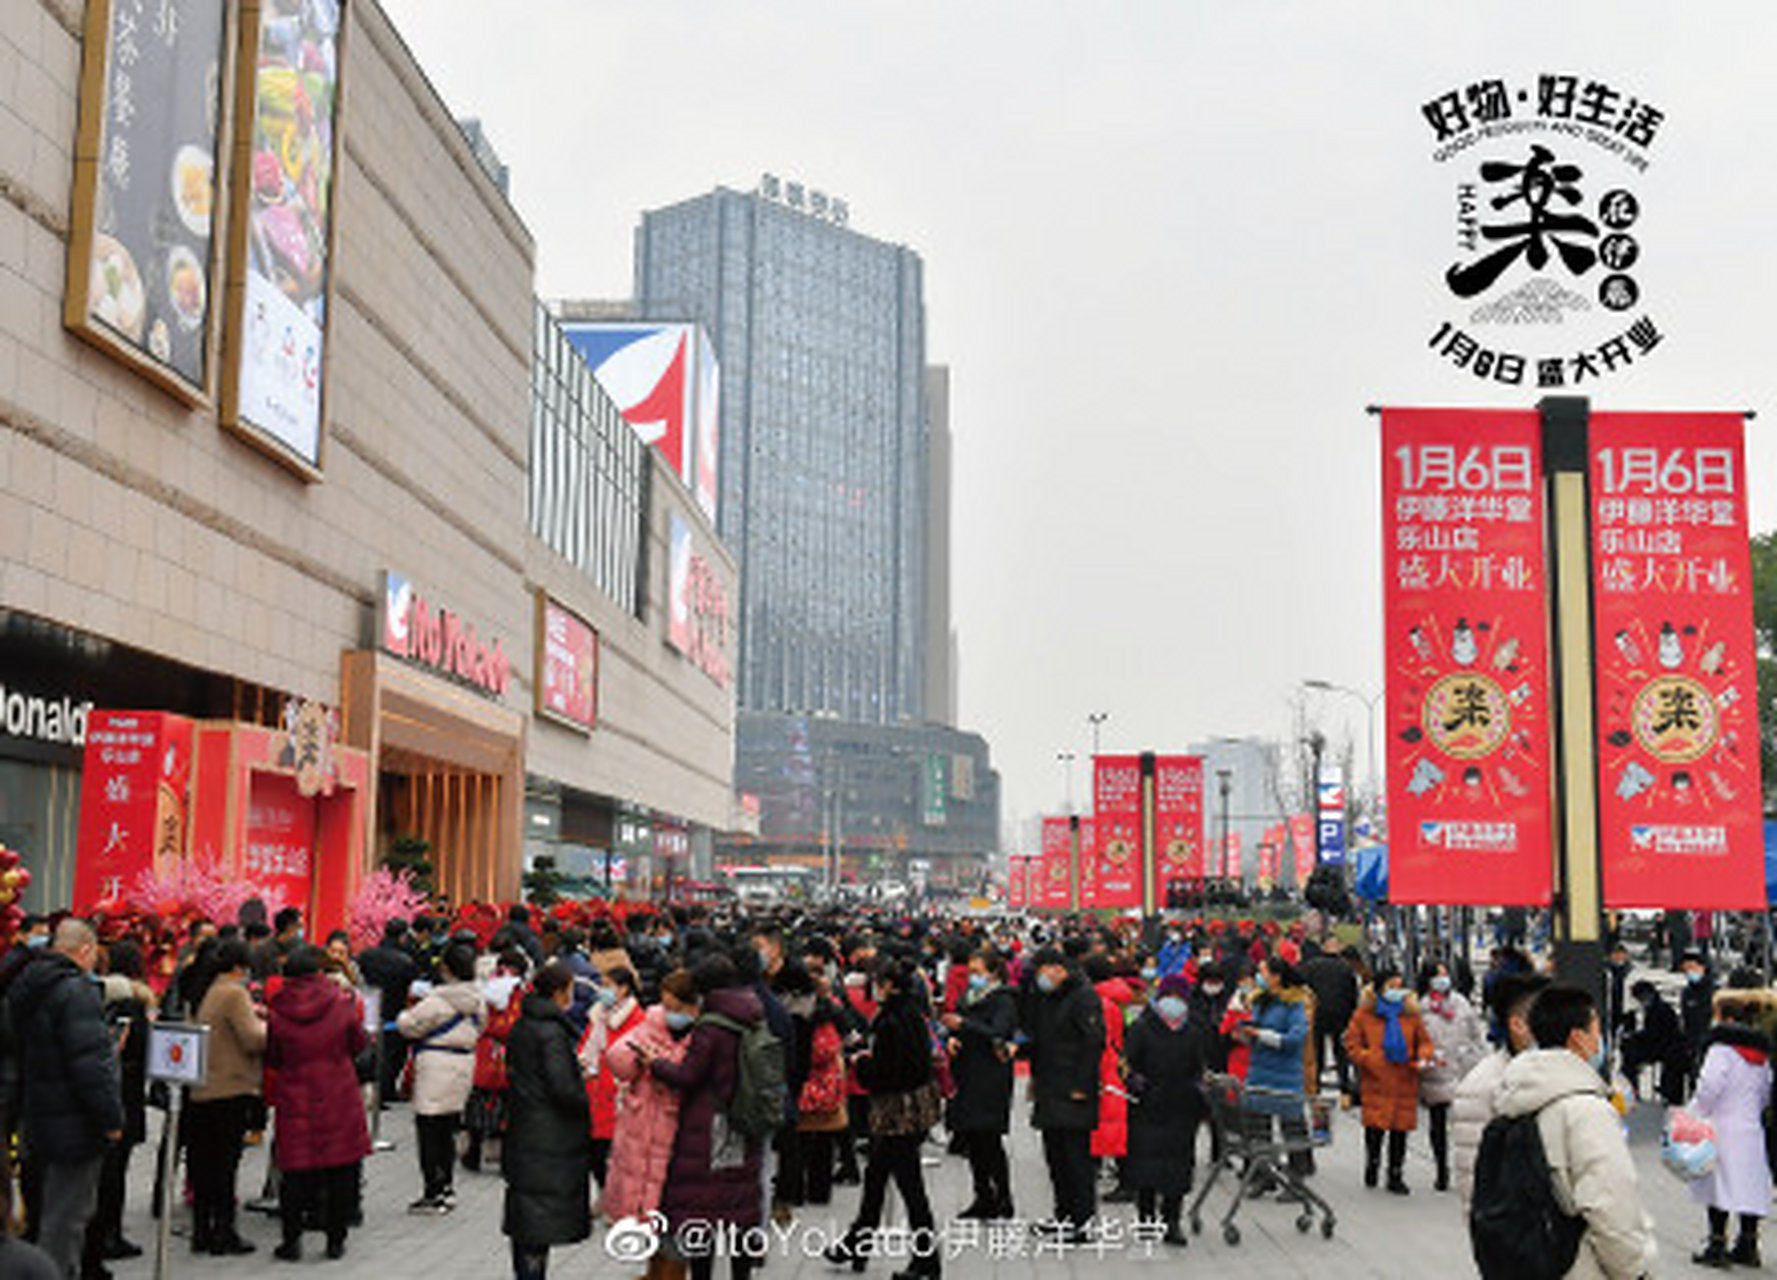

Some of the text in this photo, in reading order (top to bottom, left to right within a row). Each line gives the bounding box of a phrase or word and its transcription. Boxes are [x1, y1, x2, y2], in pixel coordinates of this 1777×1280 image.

[1395, 444, 1532, 491] 1月6日
[1597, 446, 1734, 494] 1月6日
[1320, 822, 1338, 845] P
